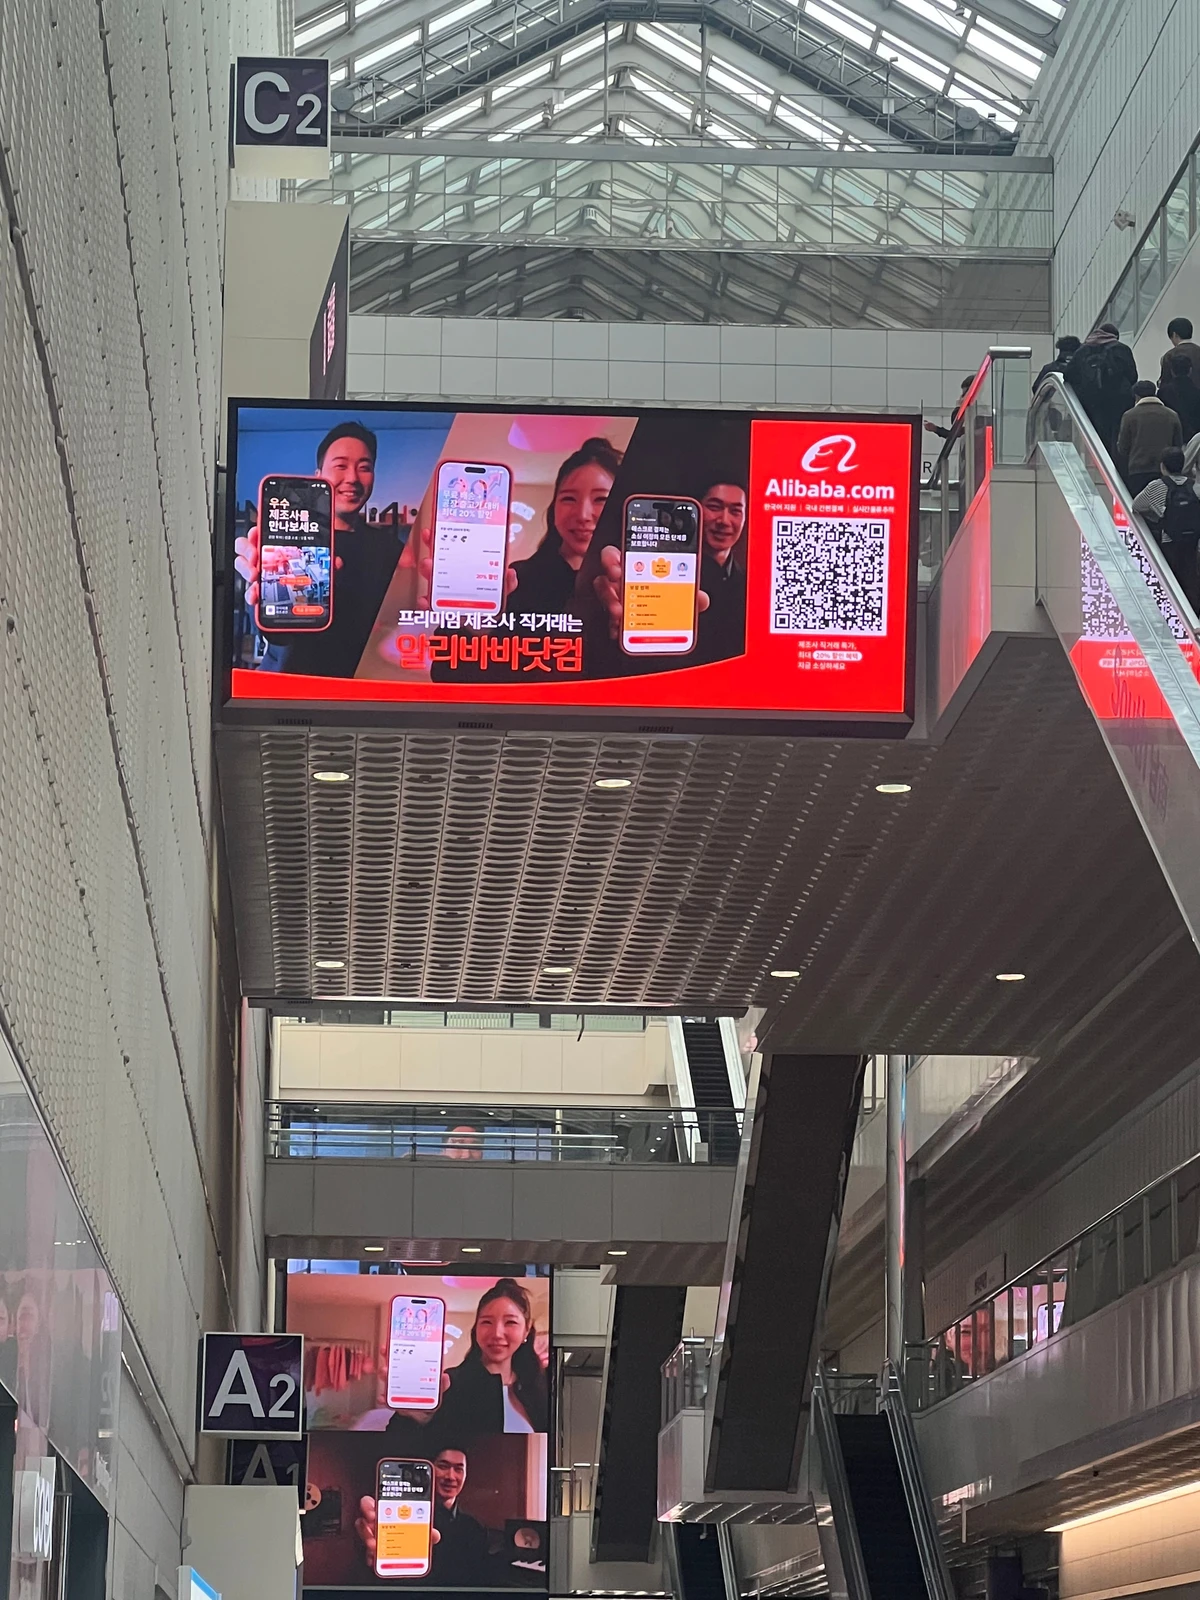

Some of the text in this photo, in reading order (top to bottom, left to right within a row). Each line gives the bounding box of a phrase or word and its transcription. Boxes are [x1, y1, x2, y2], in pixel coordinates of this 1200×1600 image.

[243, 71, 322, 135] C2
[765, 478, 895, 500] Alibaba.com
[268, 497, 290, 509] 우수
[459, 509, 476, 517] 20%
[268, 509, 309, 522] 제조사를
[268, 521, 320, 533] 만나보세요
[397, 610, 583, 632] 프리미엄 제조사 직거래는
[396, 633, 583, 672] 알리바바닷컴
[208, 1349, 297, 1418] A2
[241, 1443, 299, 1485] A1
